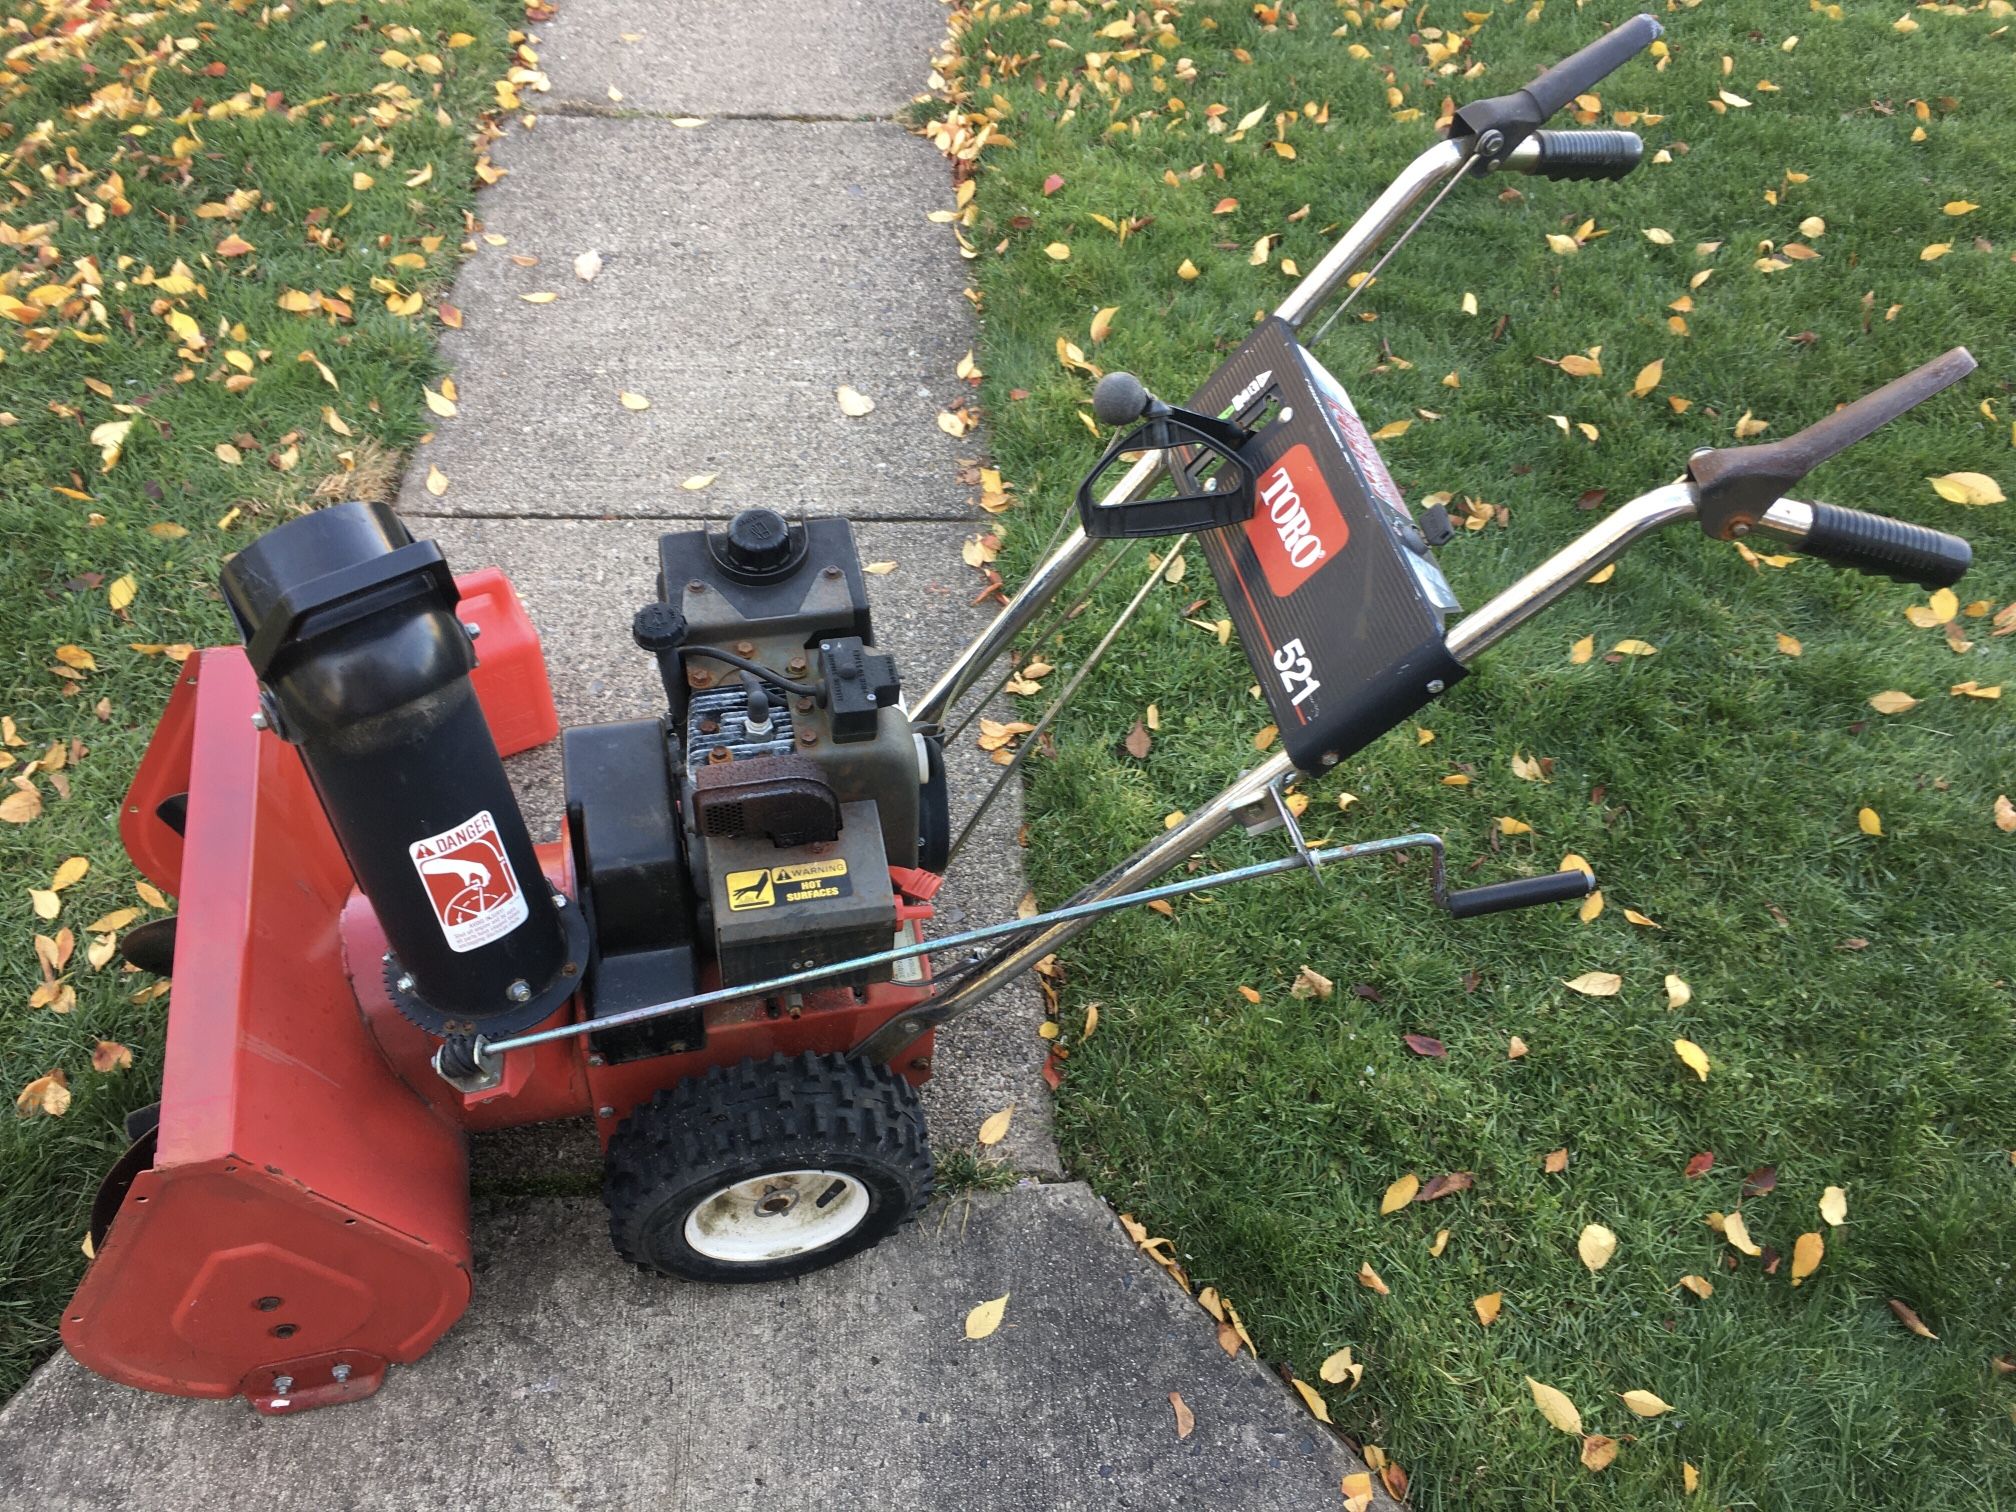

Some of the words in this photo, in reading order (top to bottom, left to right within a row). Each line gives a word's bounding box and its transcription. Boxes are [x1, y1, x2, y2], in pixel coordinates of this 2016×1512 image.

[1260, 467, 1323, 568] TORO
[1273, 638, 1321, 706] 521
[436, 814, 491, 853] DANGER
[791, 863, 845, 877] WARNING
[786, 887, 840, 901] SURFACES
[801, 879, 822, 890] HOT
